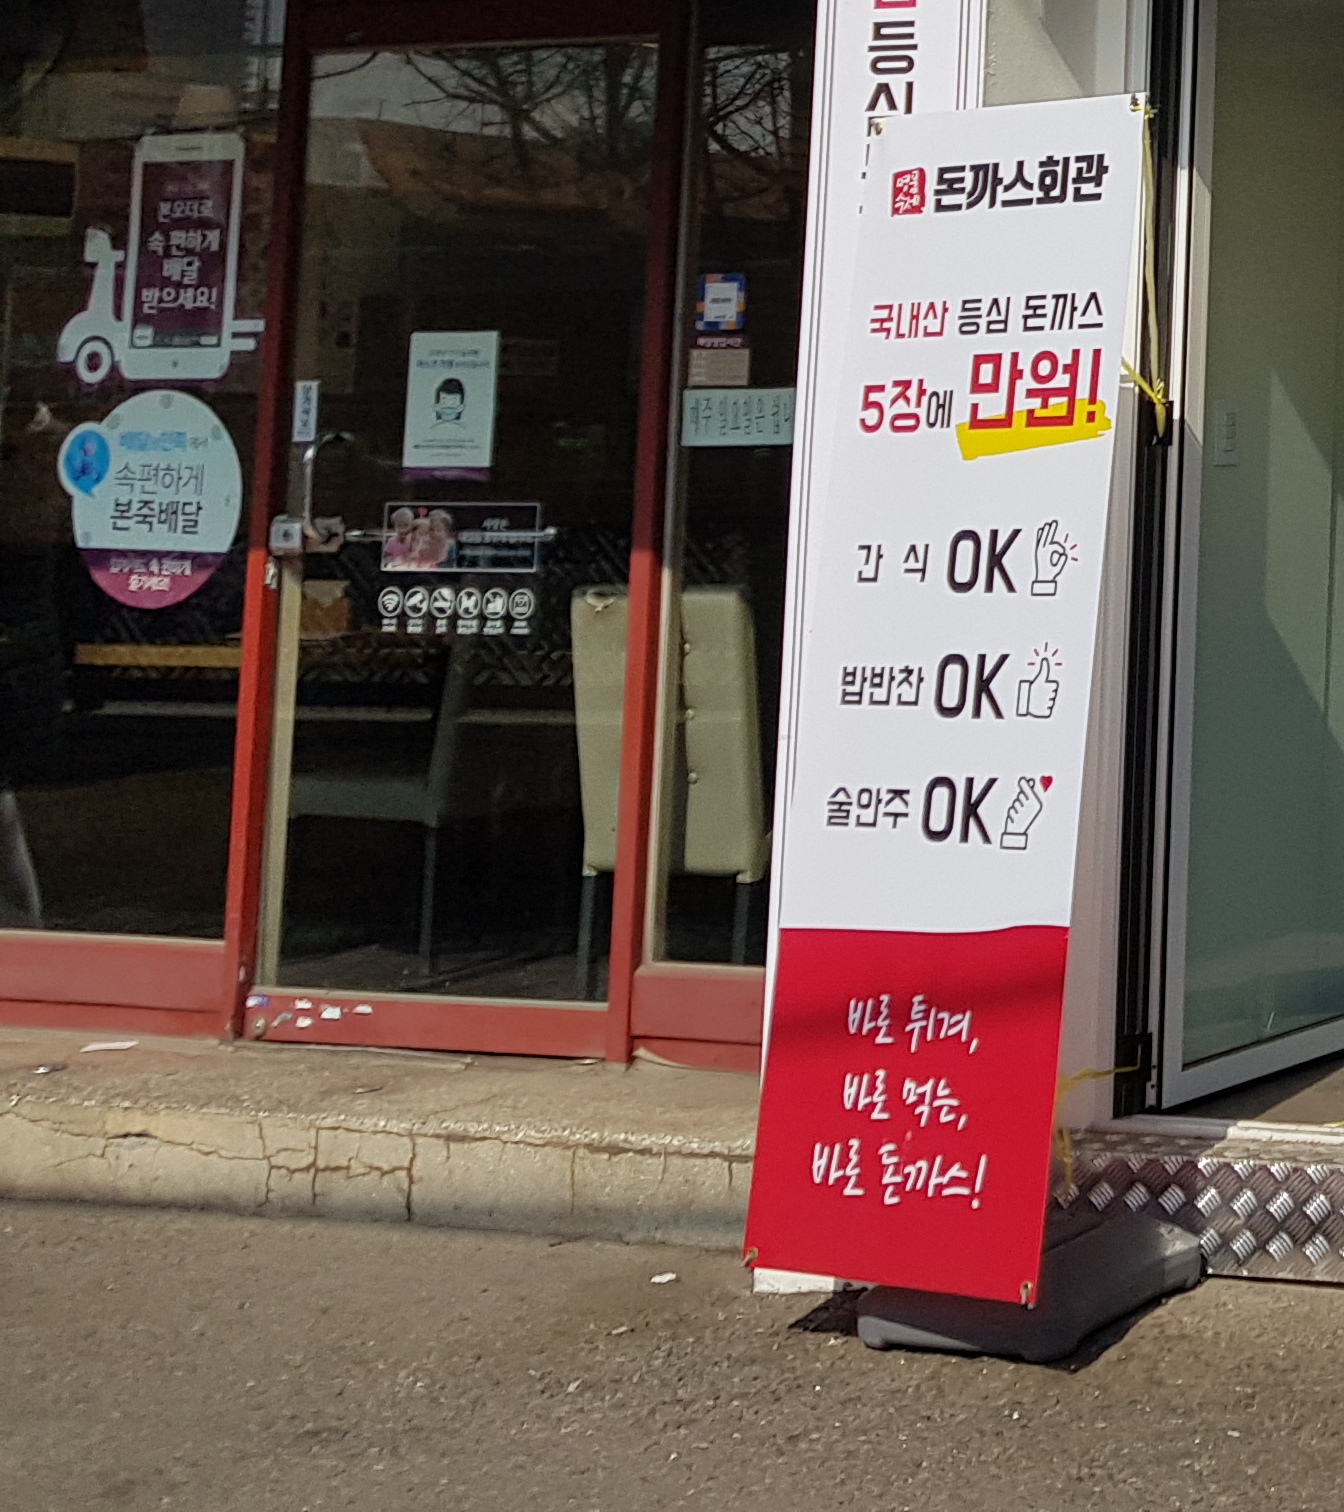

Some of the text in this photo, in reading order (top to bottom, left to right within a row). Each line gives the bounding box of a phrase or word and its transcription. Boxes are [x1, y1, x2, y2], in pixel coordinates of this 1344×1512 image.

[932, 152, 1110, 214] 돈까스회관
[869, 290, 1106, 342] 국내산 등심 돈까스
[858, 346, 1103, 435] 5장에 만원!
[114, 462, 205, 496] 속편하게
[110, 497, 203, 535] 본죽배달
[946, 528, 1023, 595] OK
[840, 652, 1011, 721] 밥반찬 OK
[826, 774, 998, 847] 술안주 OK
[846, 993, 980, 1055] 바로 튀겨,
[843, 1069, 968, 1130] 바로 먹는,
[810, 1142, 987, 1209] 바로 돈까스!
